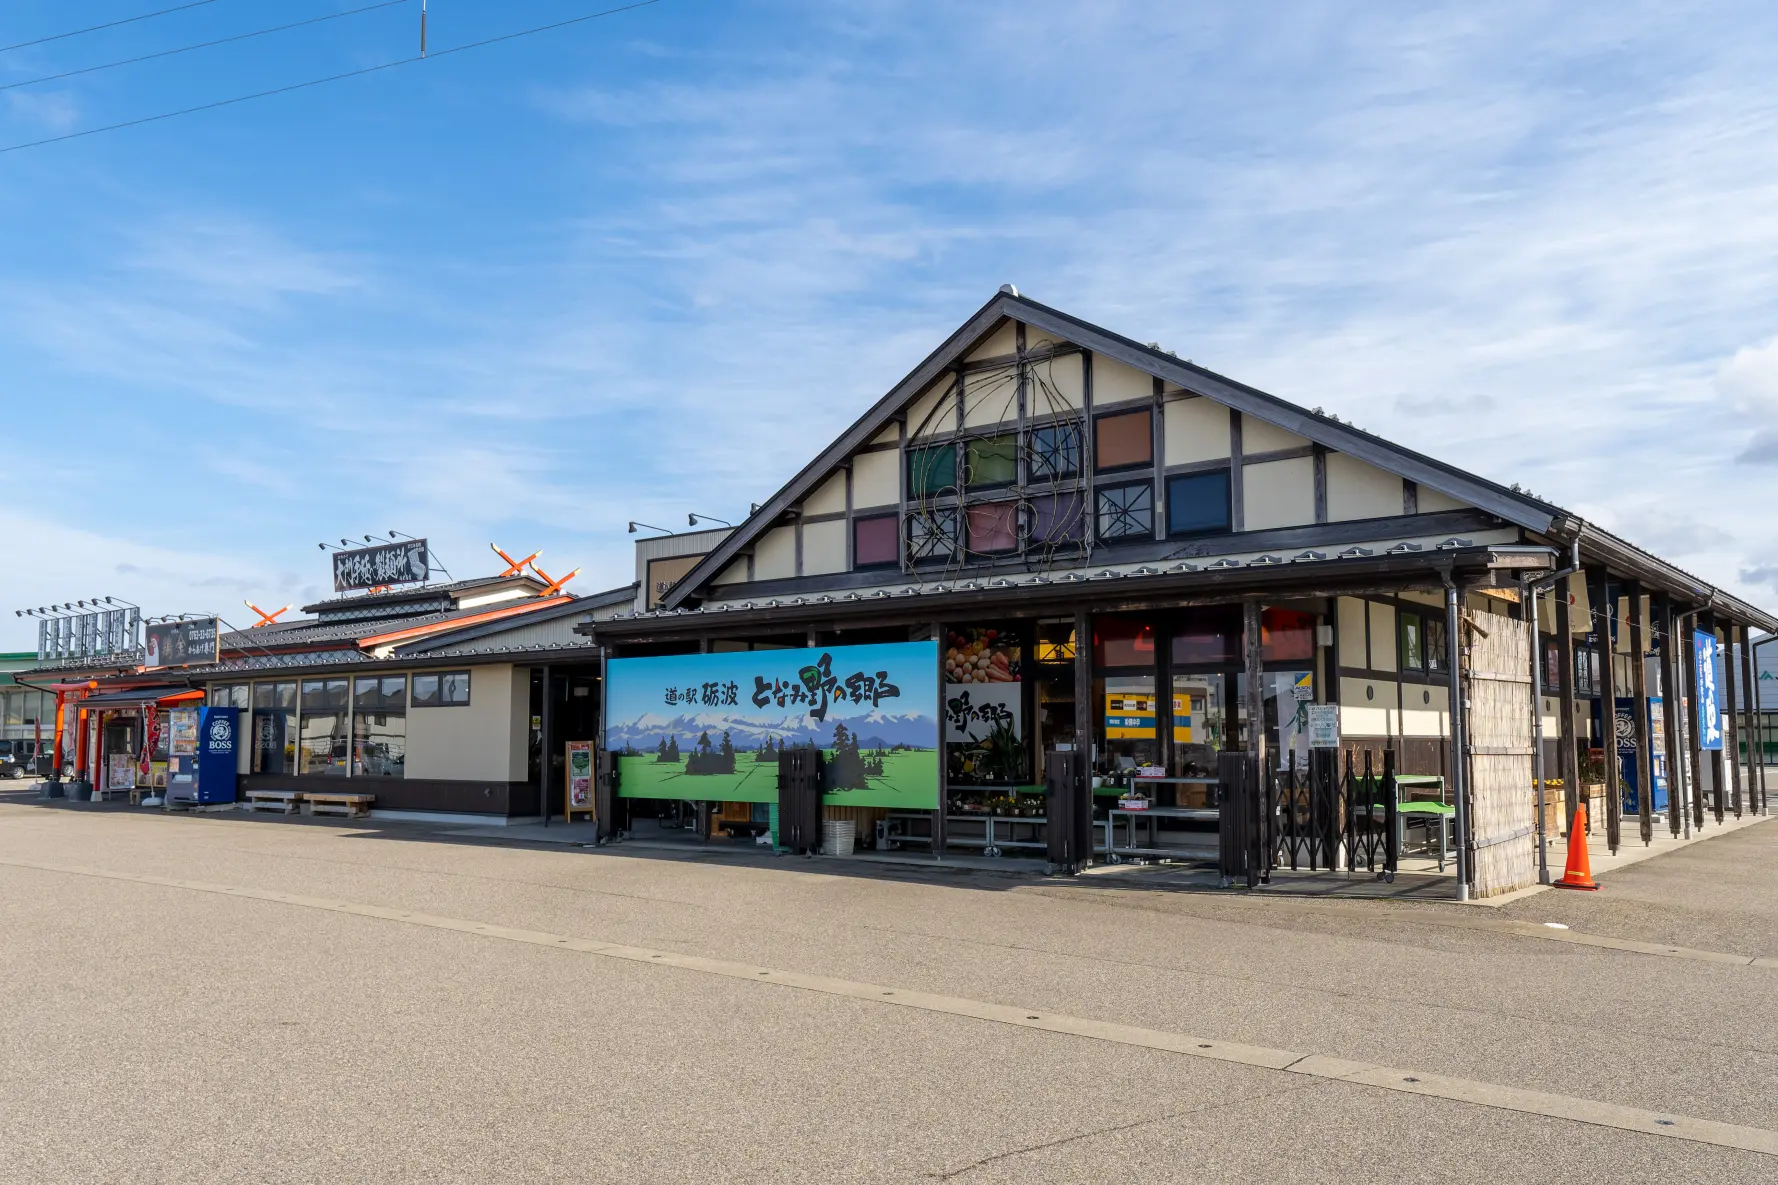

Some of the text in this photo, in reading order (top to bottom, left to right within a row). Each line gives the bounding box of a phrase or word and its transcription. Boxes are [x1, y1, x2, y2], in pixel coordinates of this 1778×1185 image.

[188, 642, 215, 655] からあげ専門
[664, 652, 900, 722] 道の駅 砺波 となみ野の郷
[209, 740, 232, 749] BOSS
[1616, 738, 1637, 748] OSS
